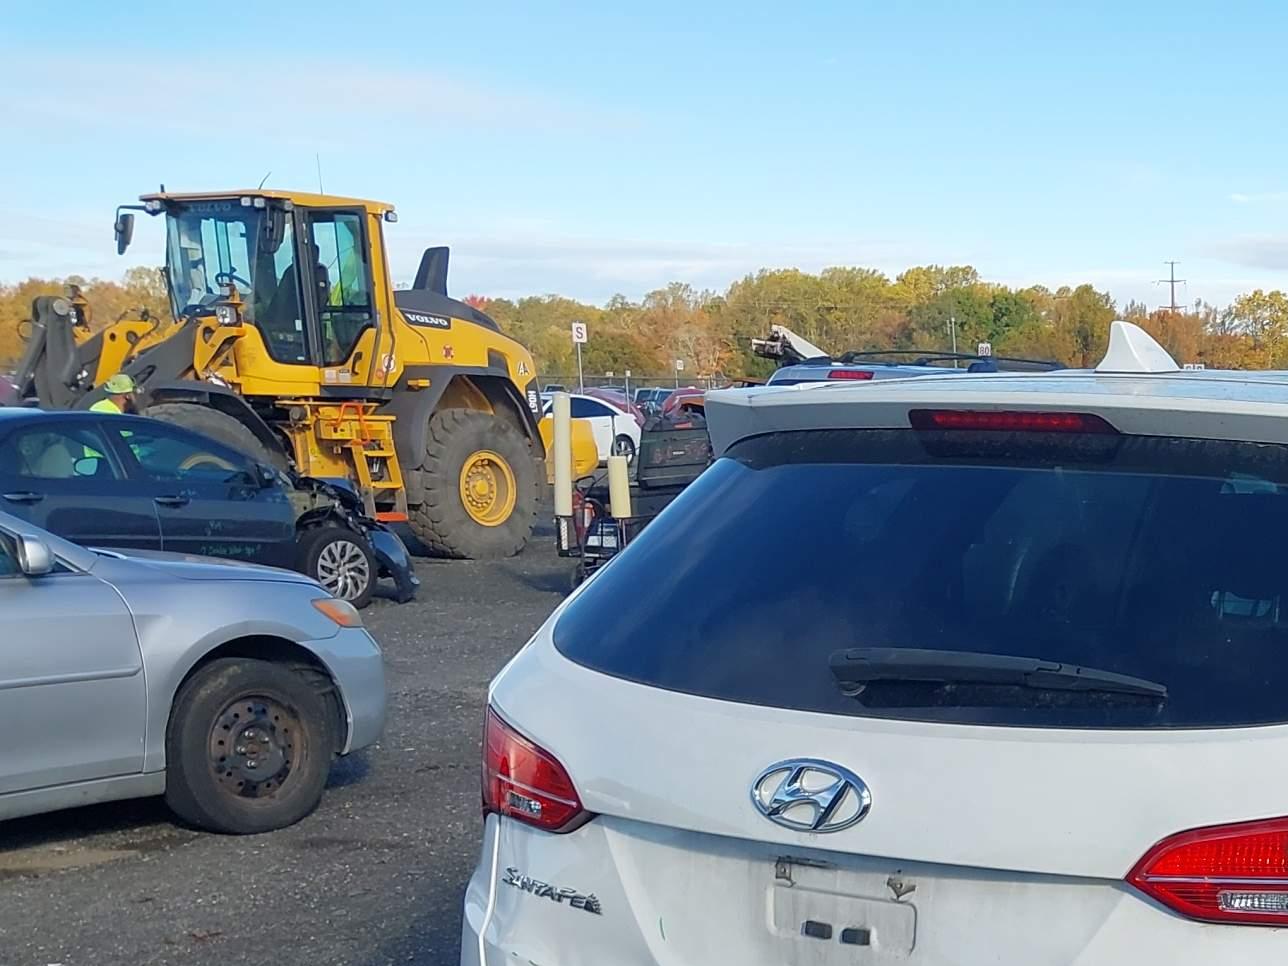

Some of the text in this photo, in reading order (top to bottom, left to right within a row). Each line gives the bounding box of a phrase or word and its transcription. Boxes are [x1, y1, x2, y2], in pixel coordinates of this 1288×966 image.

[405, 313, 449, 326] VOLVO
[576, 326, 583, 339] S
[527, 390, 538, 413] L90H
